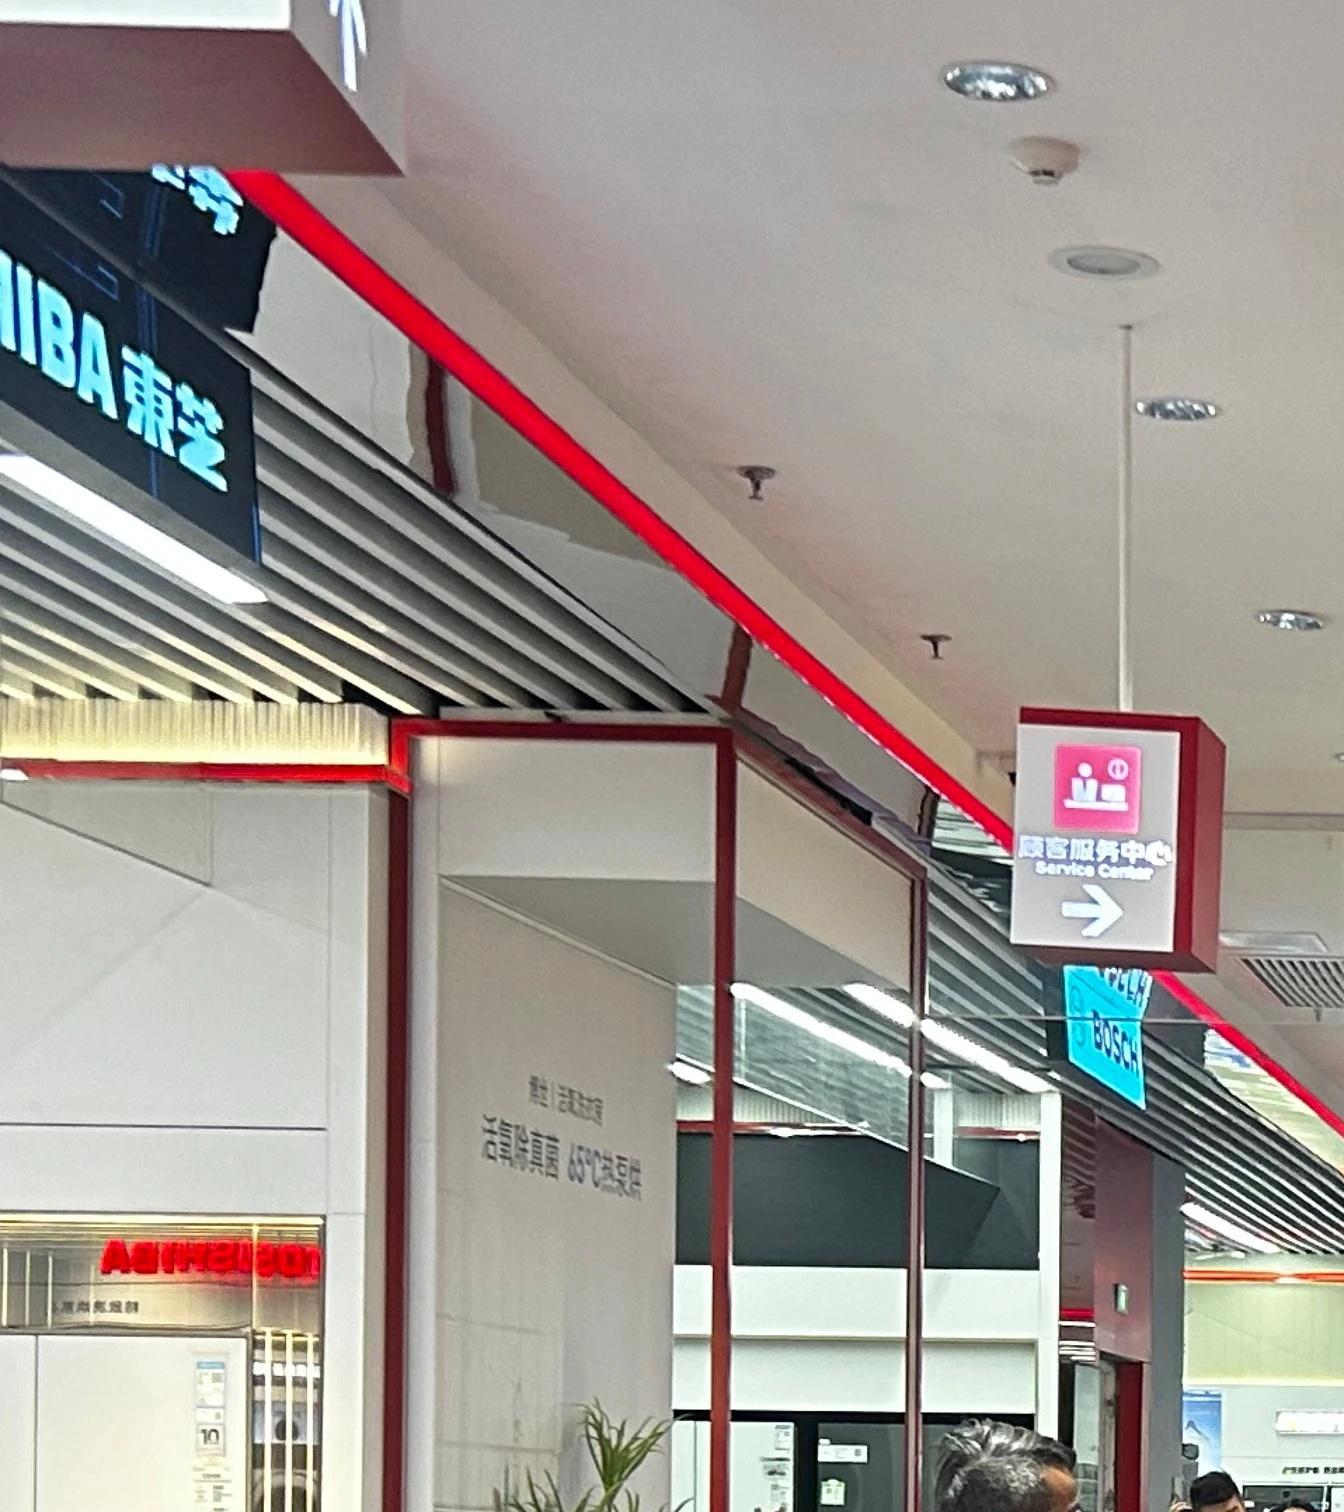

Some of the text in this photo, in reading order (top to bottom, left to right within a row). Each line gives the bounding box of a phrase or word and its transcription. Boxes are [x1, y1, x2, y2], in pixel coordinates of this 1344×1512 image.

[121, 346, 228, 492] 東芝
[1035, 860, 1154, 880] Service Center
[1092, 1009, 1140, 1080] BOSCH
